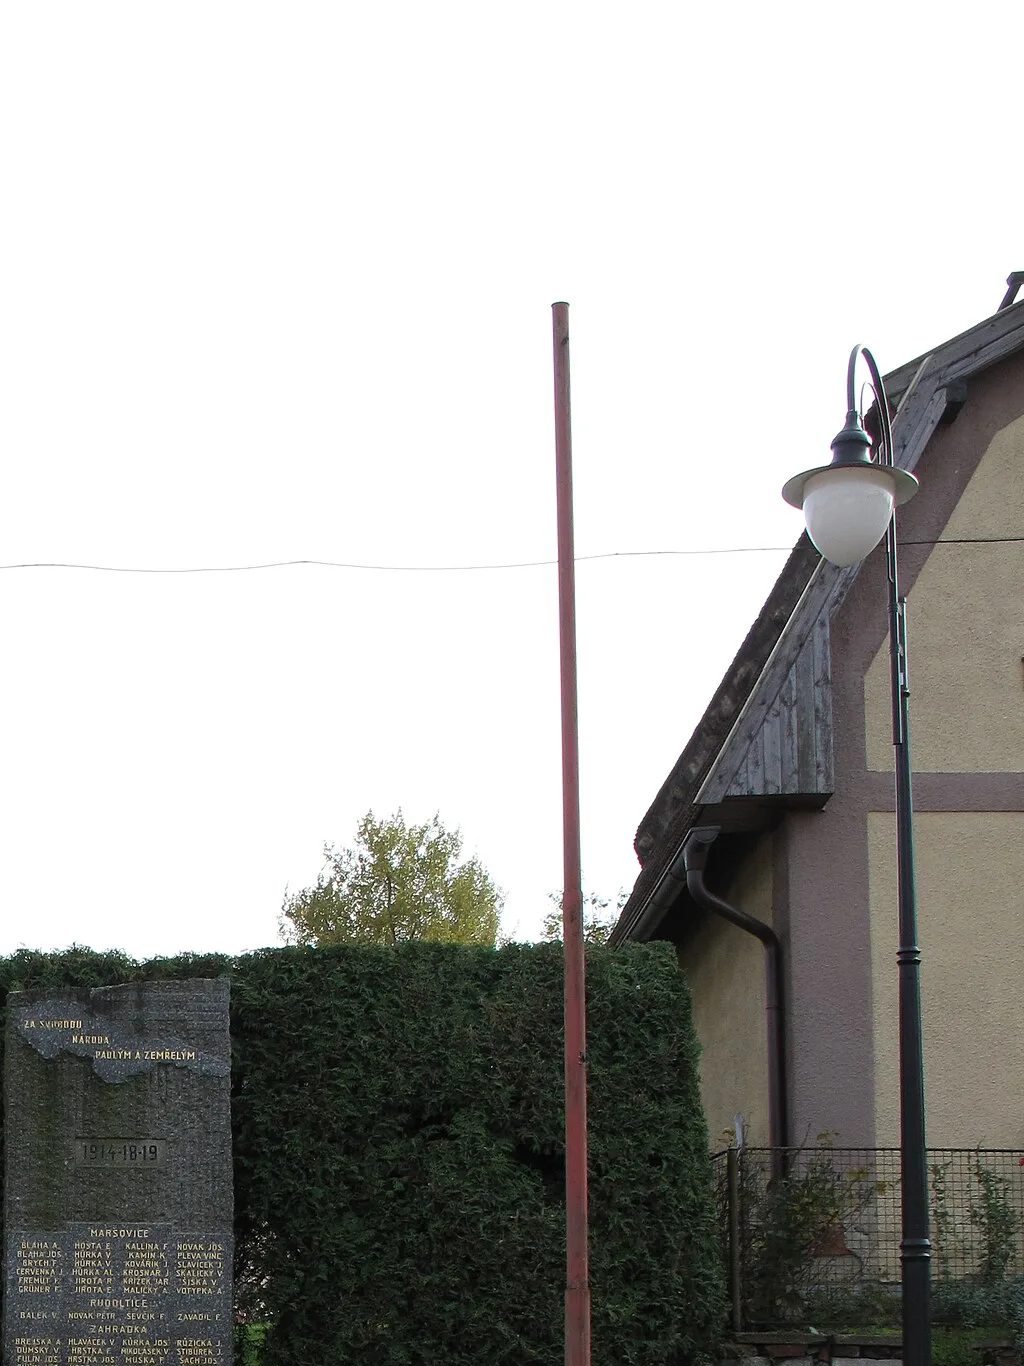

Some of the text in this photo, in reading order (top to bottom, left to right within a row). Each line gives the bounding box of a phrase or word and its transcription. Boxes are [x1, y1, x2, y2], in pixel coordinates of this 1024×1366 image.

[24, 1020, 35, 1029] ZA
[95, 1048, 196, 1060] PADLÝM A ZEMŘELÝM
[90, 1227, 149, 1238] MARŠOVICE
[90, 1299, 148, 1308] RUDOLTICE
